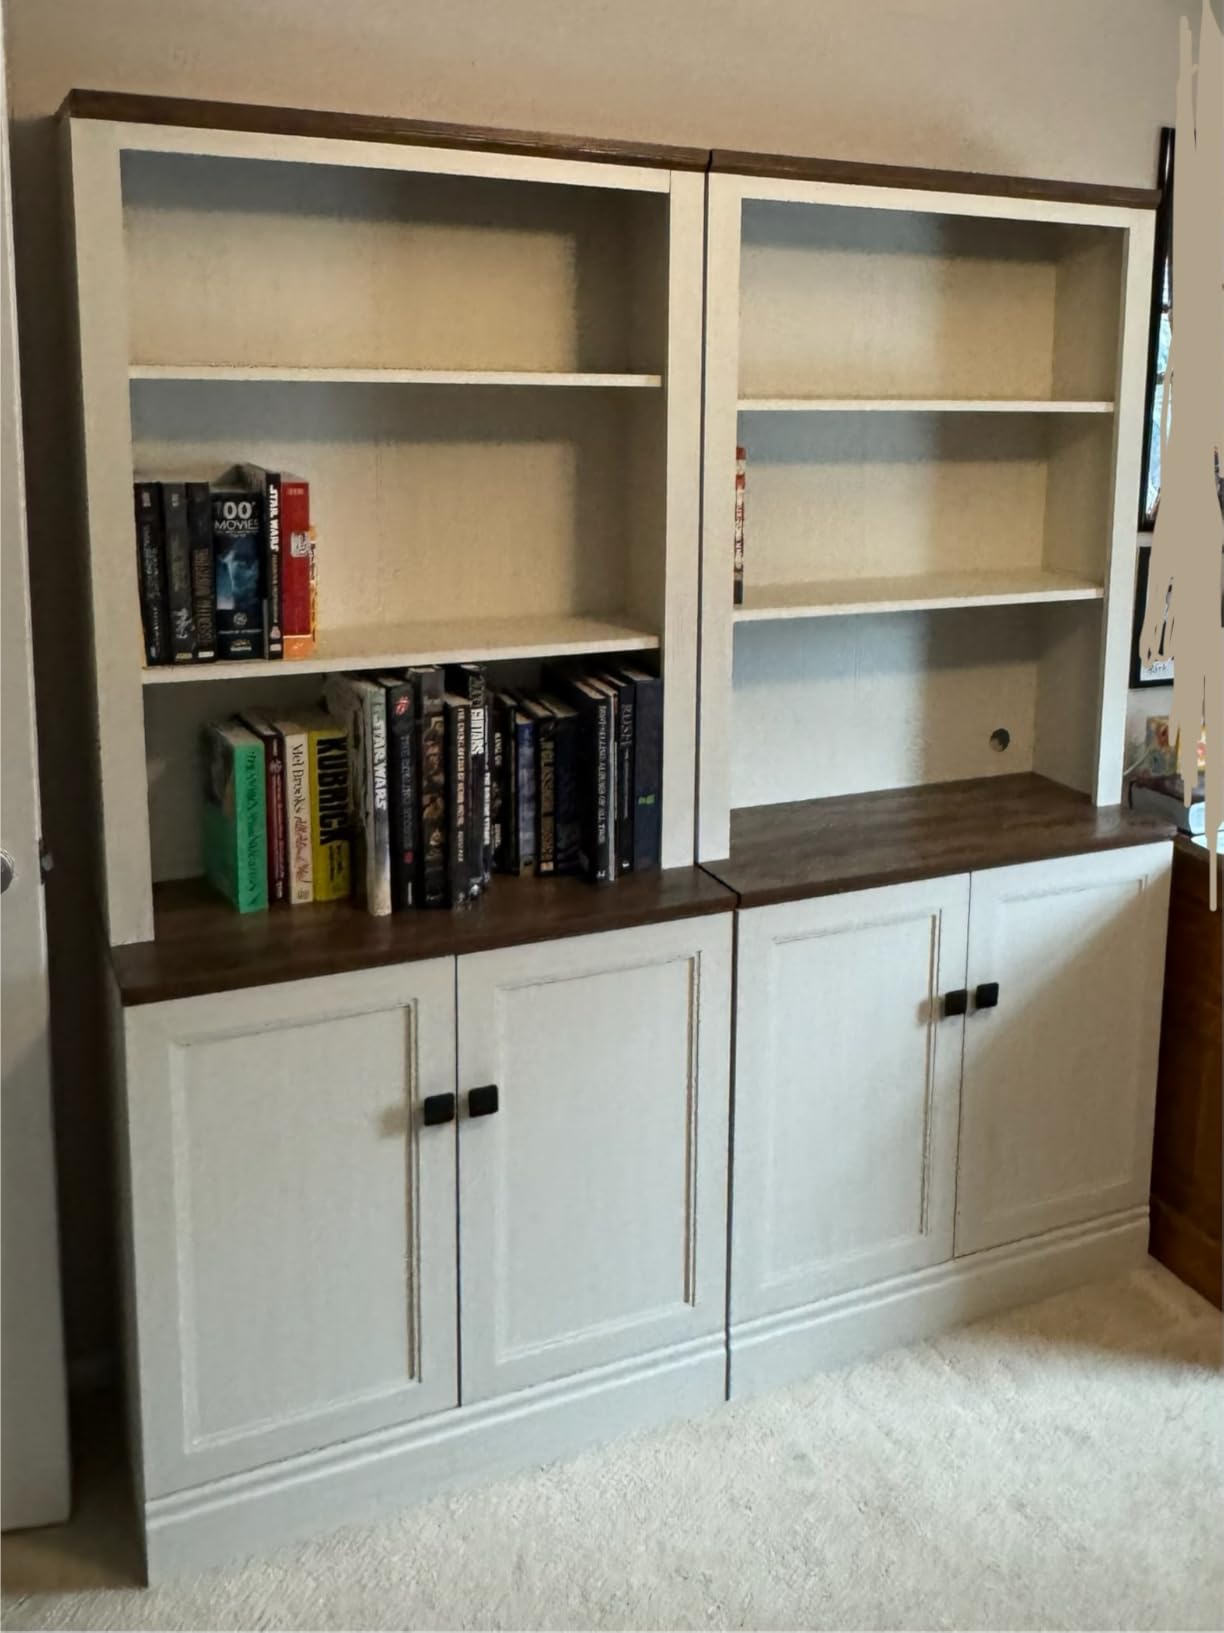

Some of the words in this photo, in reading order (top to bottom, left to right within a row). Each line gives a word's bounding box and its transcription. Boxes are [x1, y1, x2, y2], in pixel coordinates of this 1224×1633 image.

[269, 484, 279, 519] STAR
[270, 519, 280, 552] WARS
[372, 714, 387, 764] STAR
[470, 708, 484, 755] GUITARS
[619, 703, 633, 748] RUSH
[292, 743, 304, 765] Mel
[293, 770, 306, 813] Brooks
[316, 736, 350, 846] KUBRICK
[373, 764, 388, 811] WARS
